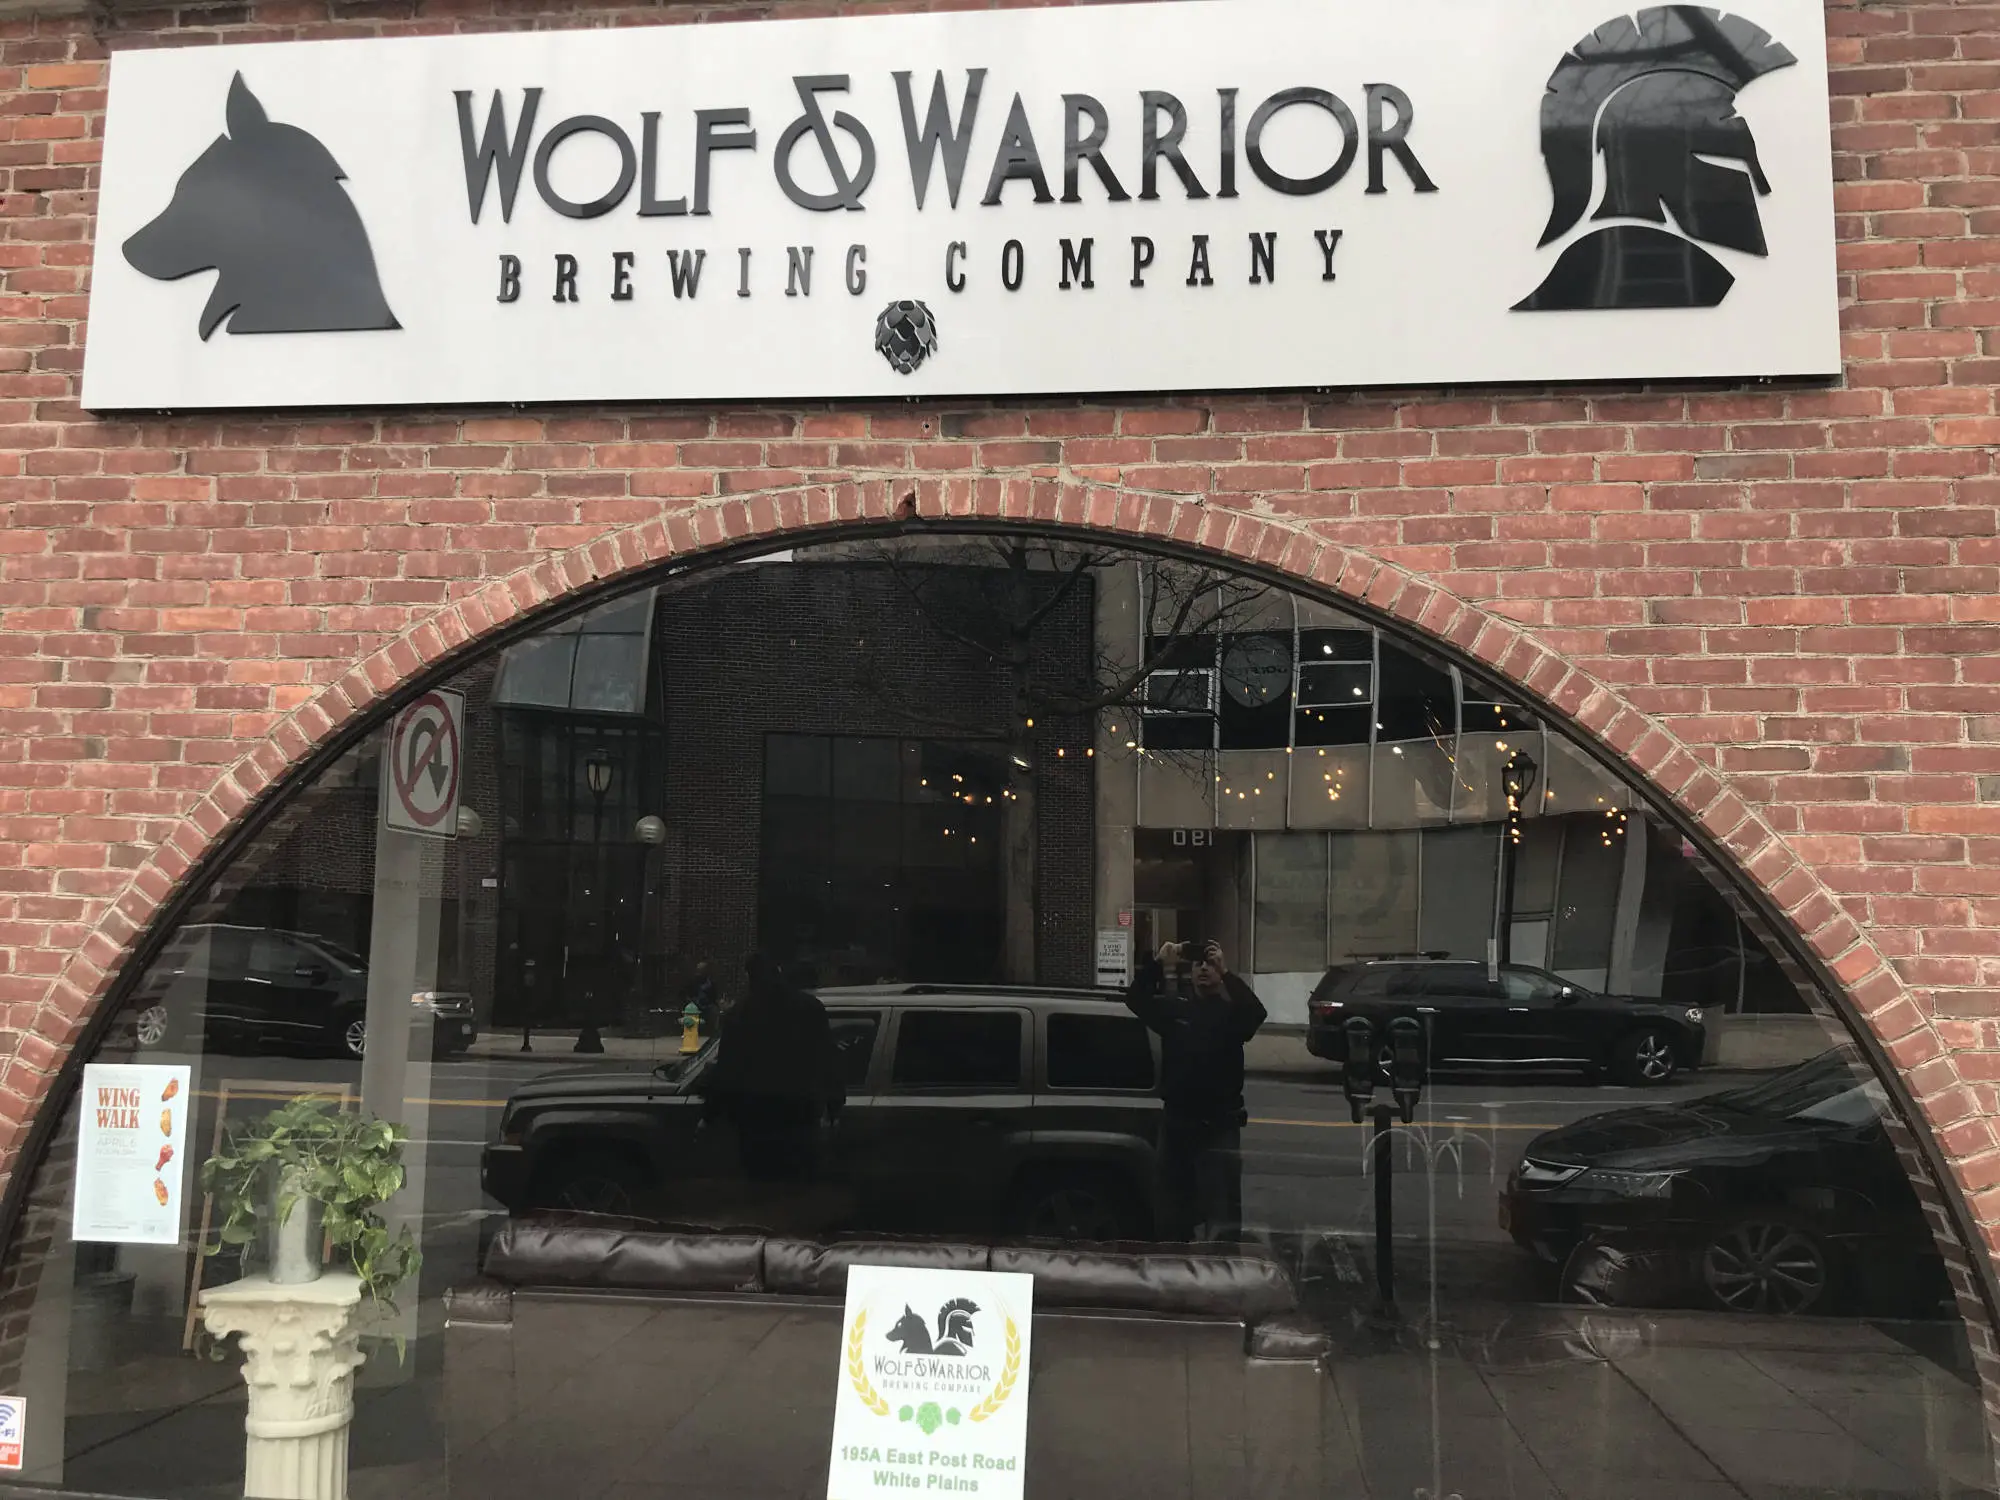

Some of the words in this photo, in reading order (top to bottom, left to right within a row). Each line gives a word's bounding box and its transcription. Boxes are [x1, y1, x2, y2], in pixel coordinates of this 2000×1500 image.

[452, 87, 757, 225] WOLF
[773, 74, 876, 212] &
[890, 68, 1440, 211] WARRIOR
[496, 244, 867, 303] BREWING
[945, 229, 1343, 293] COMPANY
[96, 1087, 141, 1108] WING
[95, 1108, 141, 1129] WALK
[882, 1379, 929, 1392] BREWING
[934, 1382, 981, 1394] COMPANY
[841, 1445, 881, 1463] 195A
[886, 1447, 923, 1466] East
[928, 1450, 968, 1468] Post
[972, 1453, 1017, 1471] Road
[873, 1469, 921, 1489] White
[926, 1473, 979, 1492] Plains
